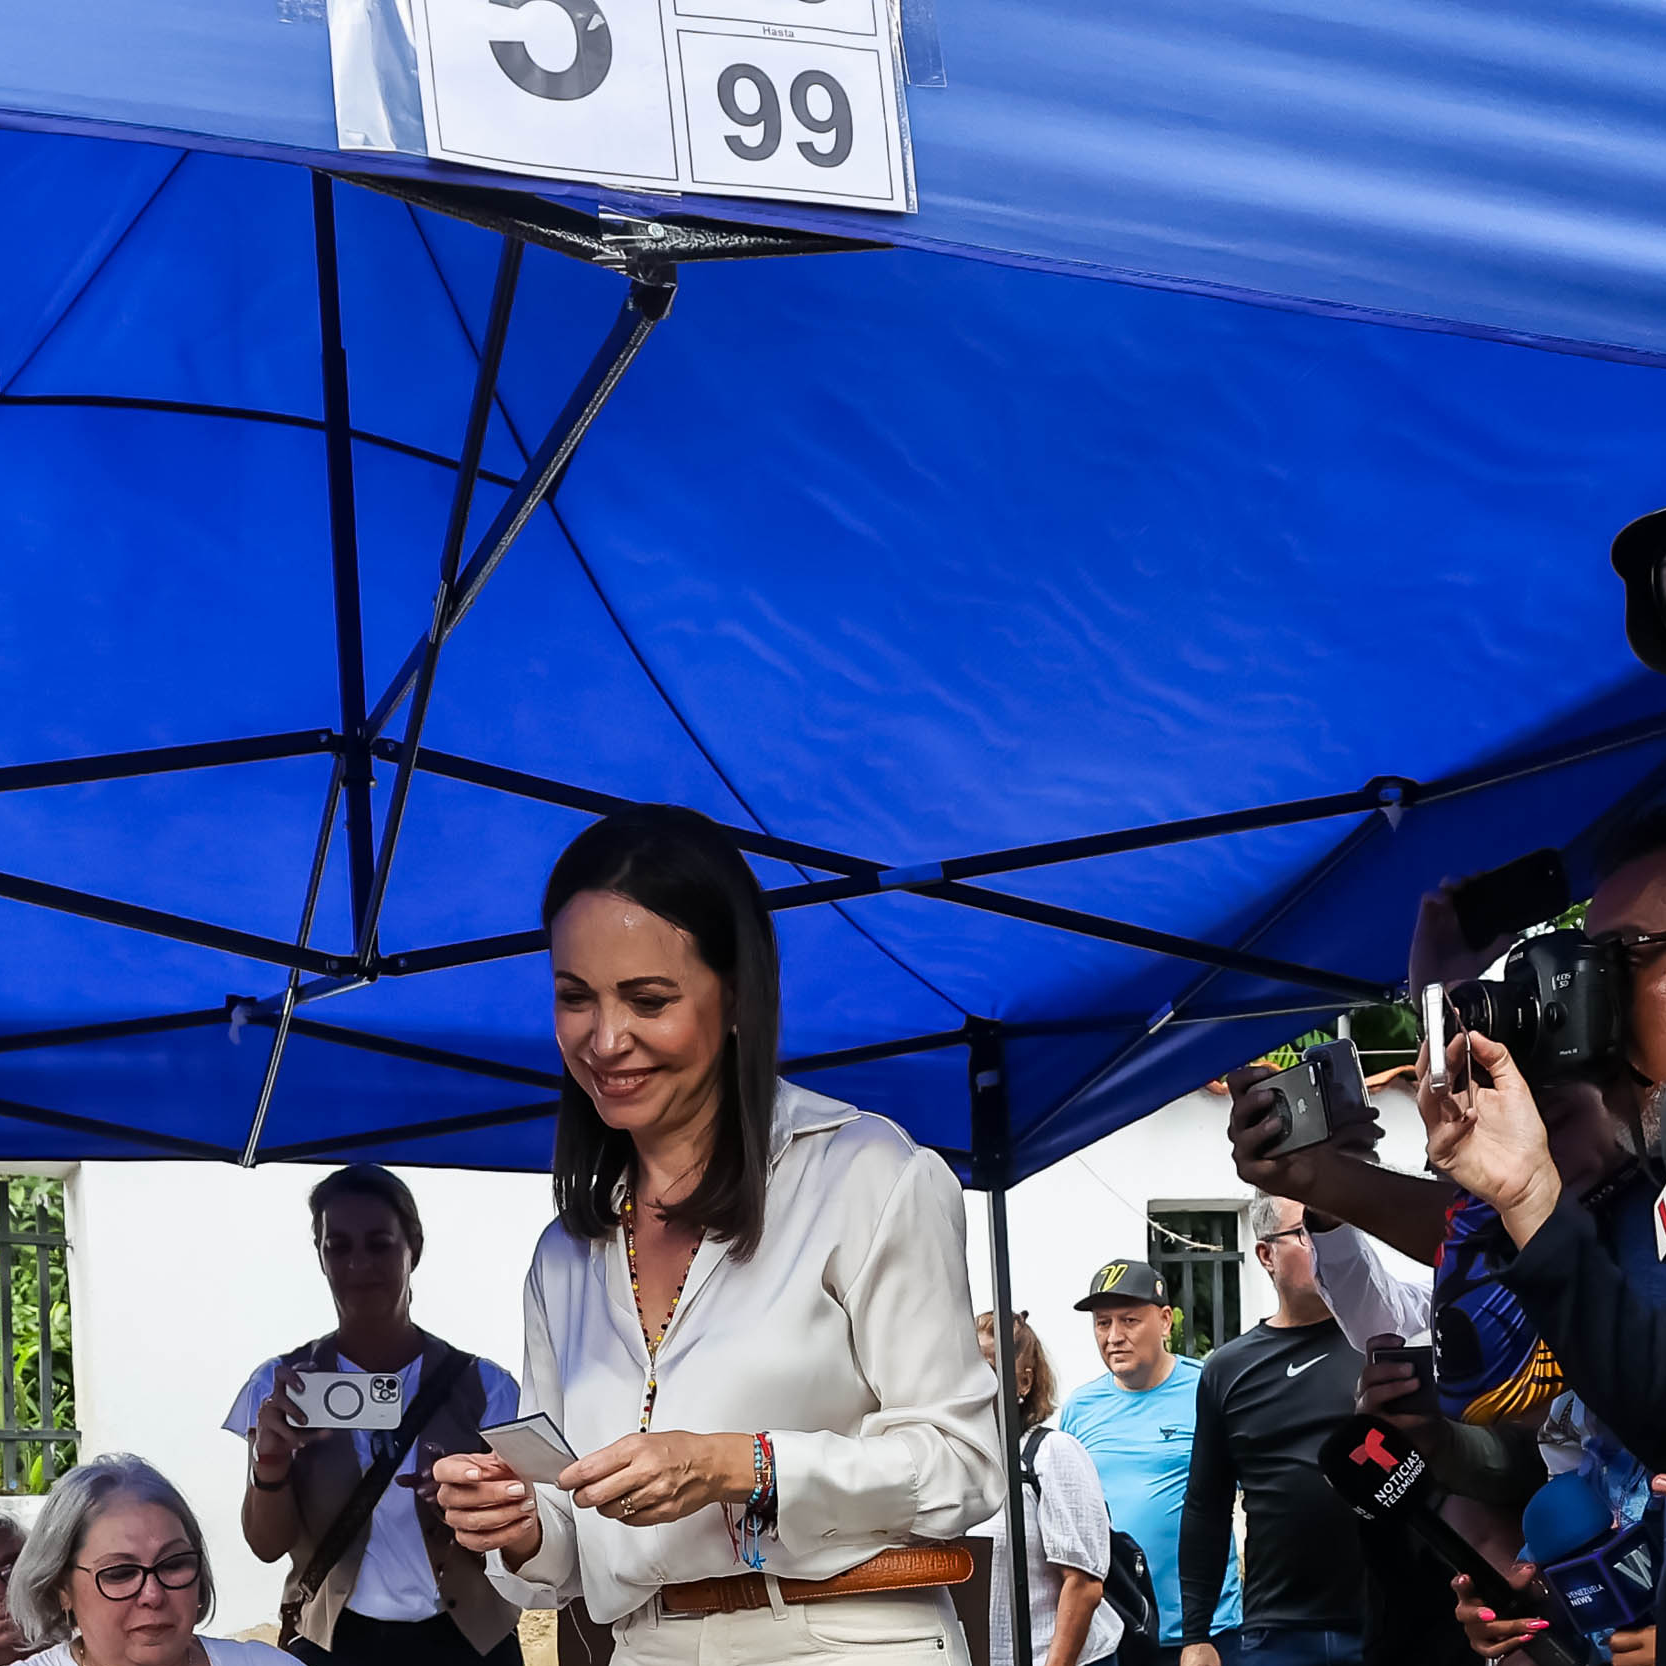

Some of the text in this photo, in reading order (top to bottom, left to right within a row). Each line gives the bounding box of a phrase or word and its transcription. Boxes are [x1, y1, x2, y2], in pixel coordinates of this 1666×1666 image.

[762, 25, 795, 38] Hasta
[717, 63, 853, 168] 99
[1374, 1450, 1420, 1503] NOTICIAS
[1382, 1459, 1426, 1508] TELEMUNDO
[1565, 1584, 1605, 1599] VENEZUELA
[1570, 1595, 1593, 1607] NEWS
